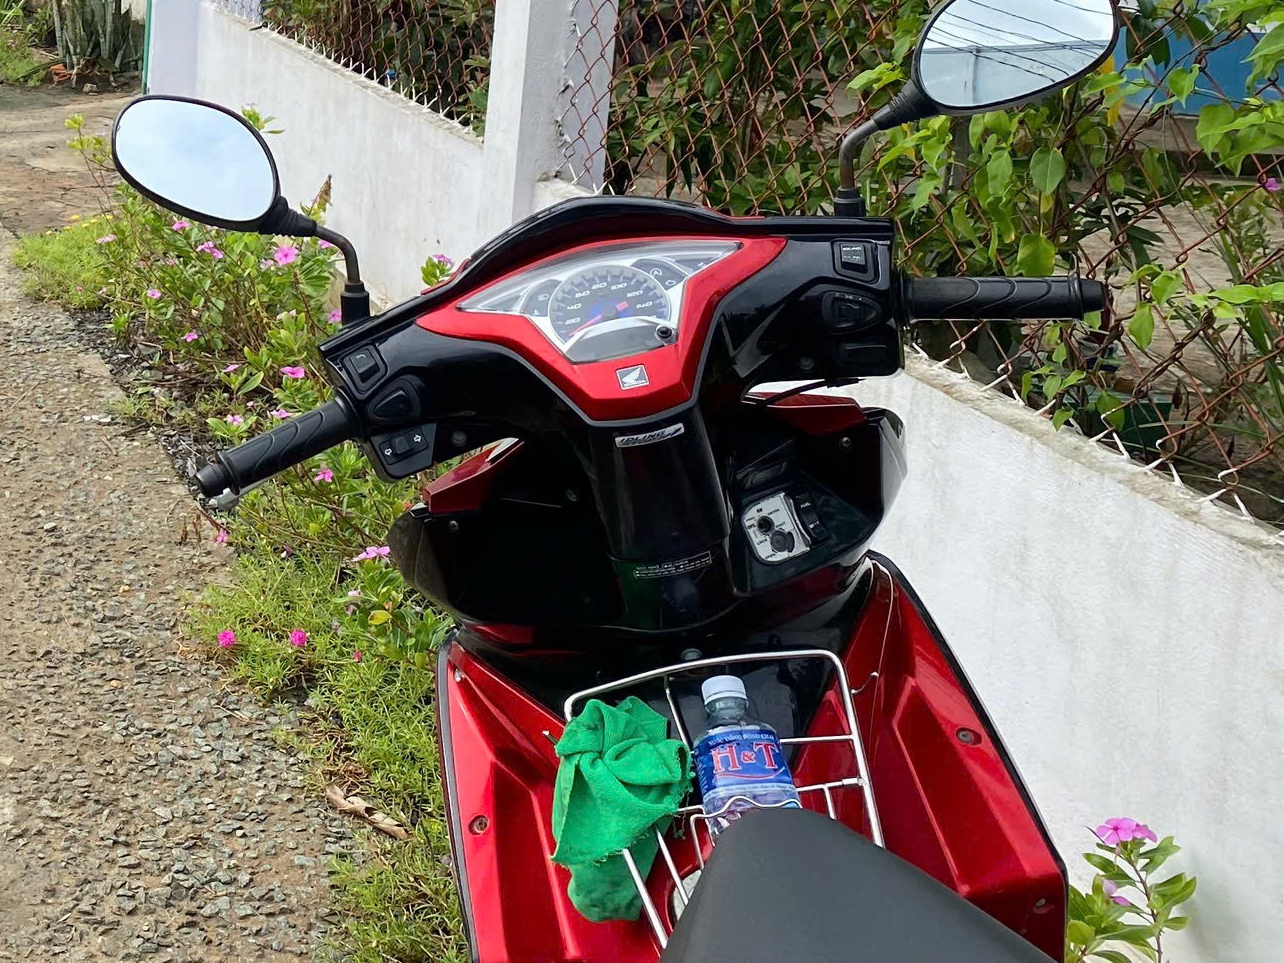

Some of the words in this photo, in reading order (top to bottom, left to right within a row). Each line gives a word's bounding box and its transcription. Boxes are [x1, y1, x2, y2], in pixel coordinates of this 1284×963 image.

[592, 282, 607, 290] 80
[610, 282, 627, 290] 100
[627, 290, 644, 298] 120
[636, 301, 653, 309] 140
[565, 317, 581, 325] 20
